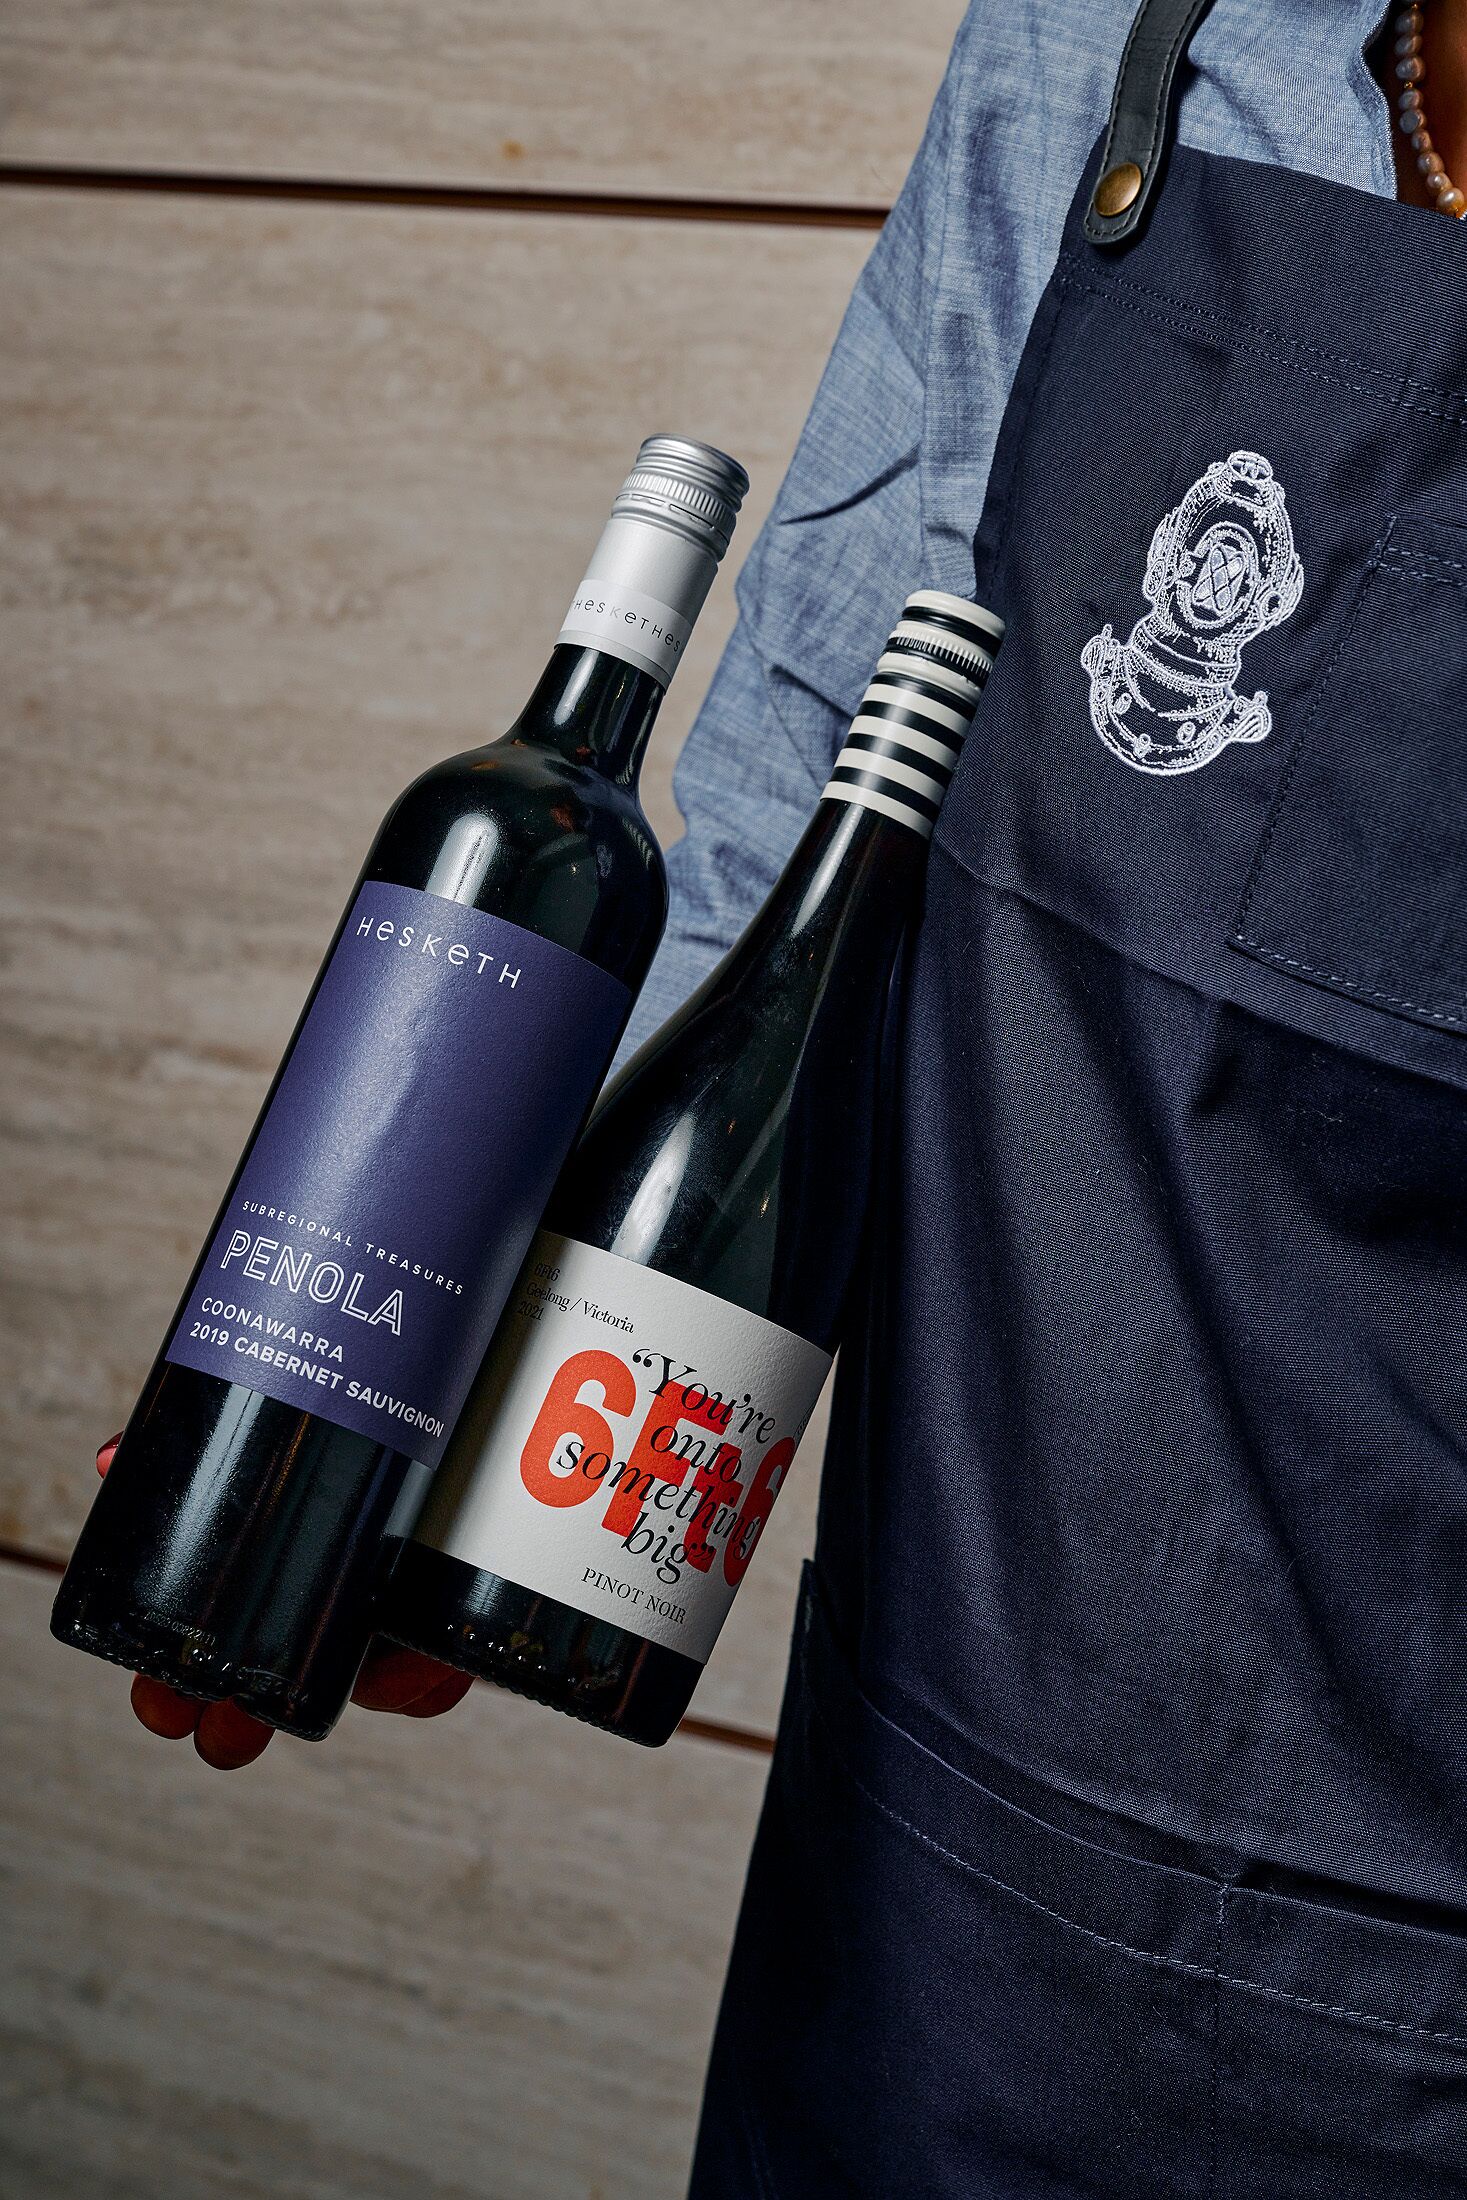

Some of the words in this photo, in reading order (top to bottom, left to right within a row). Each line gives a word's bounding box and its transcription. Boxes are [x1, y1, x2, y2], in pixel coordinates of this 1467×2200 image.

[220, 1229, 404, 1336] PENOLA
[242, 1201, 352, 1247] SUBREGIONAL
[365, 1243, 463, 1295] TREASURES
[201, 1297, 344, 1363] COONAWARRA
[526, 1282, 571, 1312] Geelong
[584, 1300, 634, 1334] Victoria
[190, 1321, 230, 1347] 2019
[234, 1337, 344, 1390] CABERNET
[345, 1381, 445, 1438] SAUVIGNON
[650, 1425, 743, 1483] onto
[556, 1441, 761, 1560] something
[581, 1567, 645, 1606] PINOT
[645, 1593, 687, 1625] NOIR
